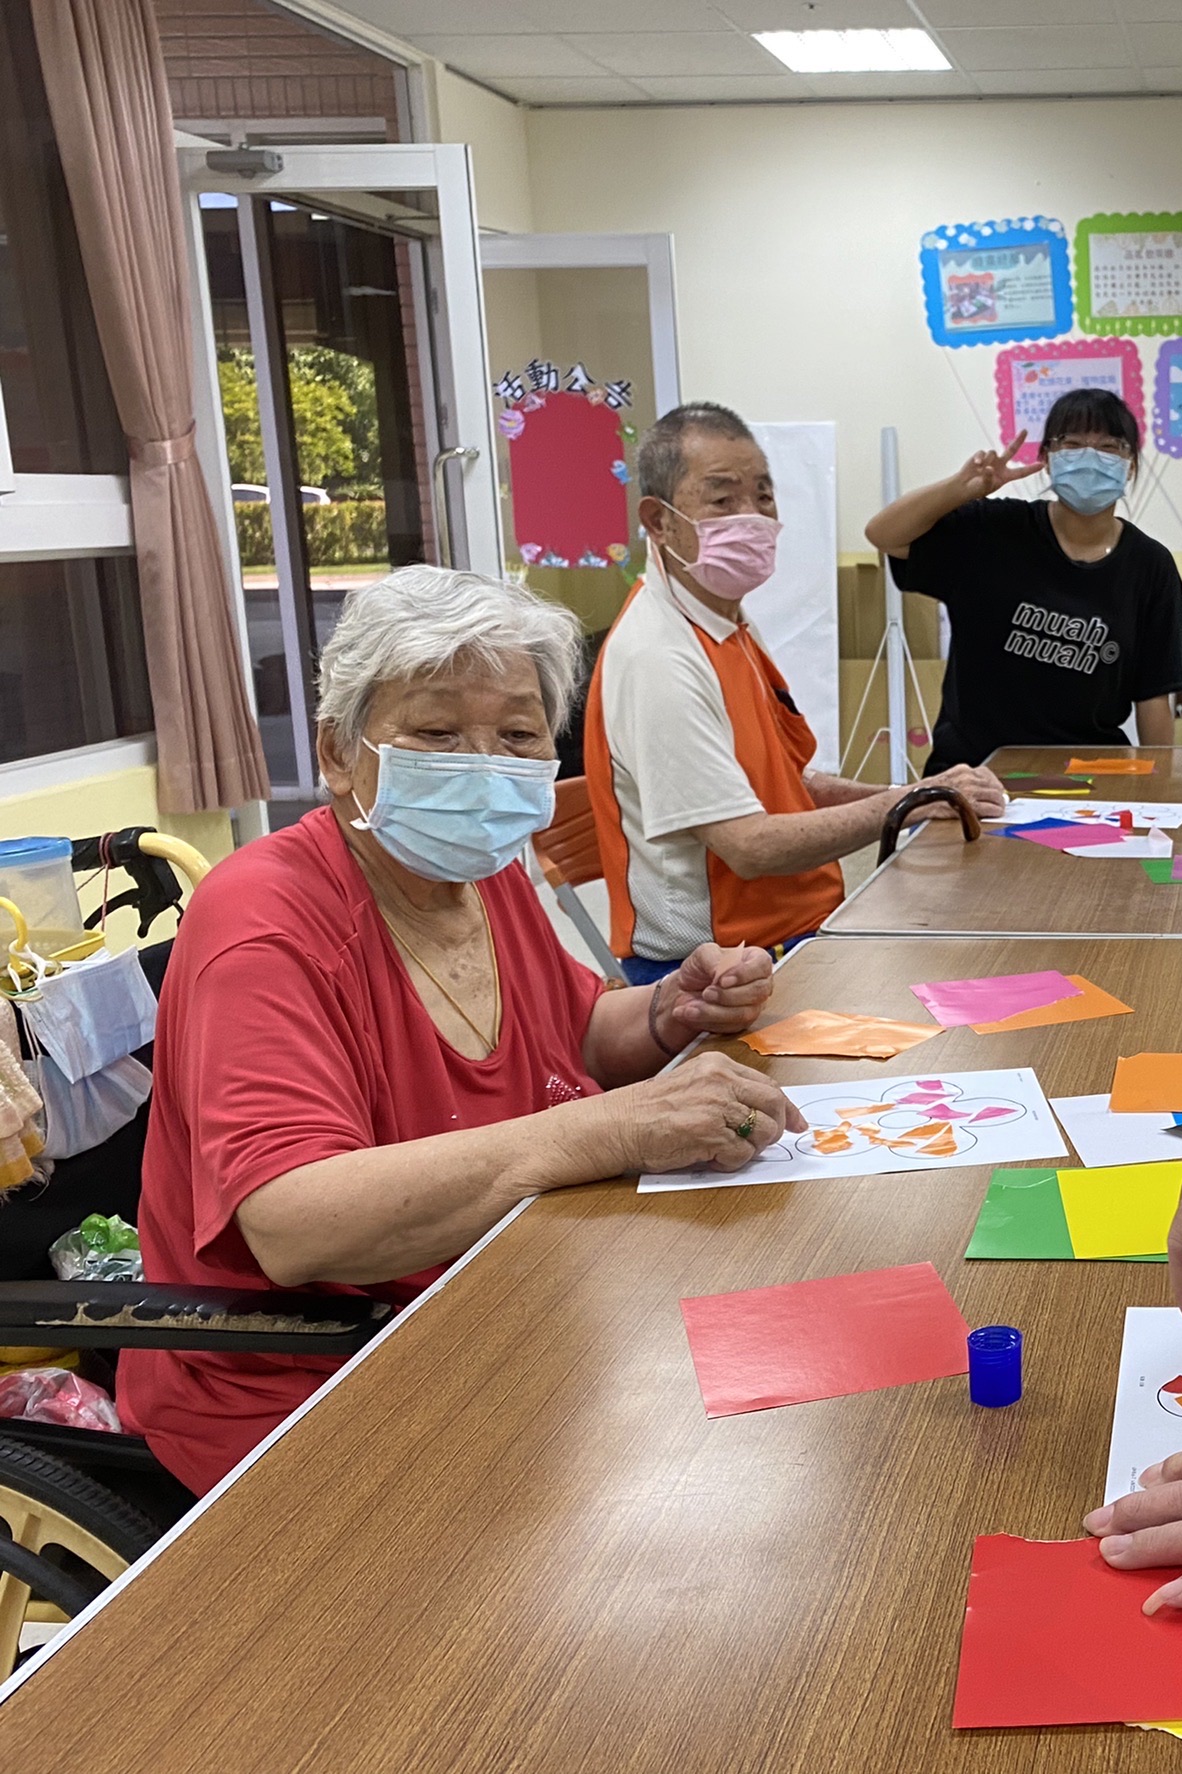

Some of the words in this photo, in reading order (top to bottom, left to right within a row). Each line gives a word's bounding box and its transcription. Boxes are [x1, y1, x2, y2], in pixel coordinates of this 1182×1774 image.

[493, 358, 633, 409] 活動公告
[1012, 602, 1109, 647] muah
